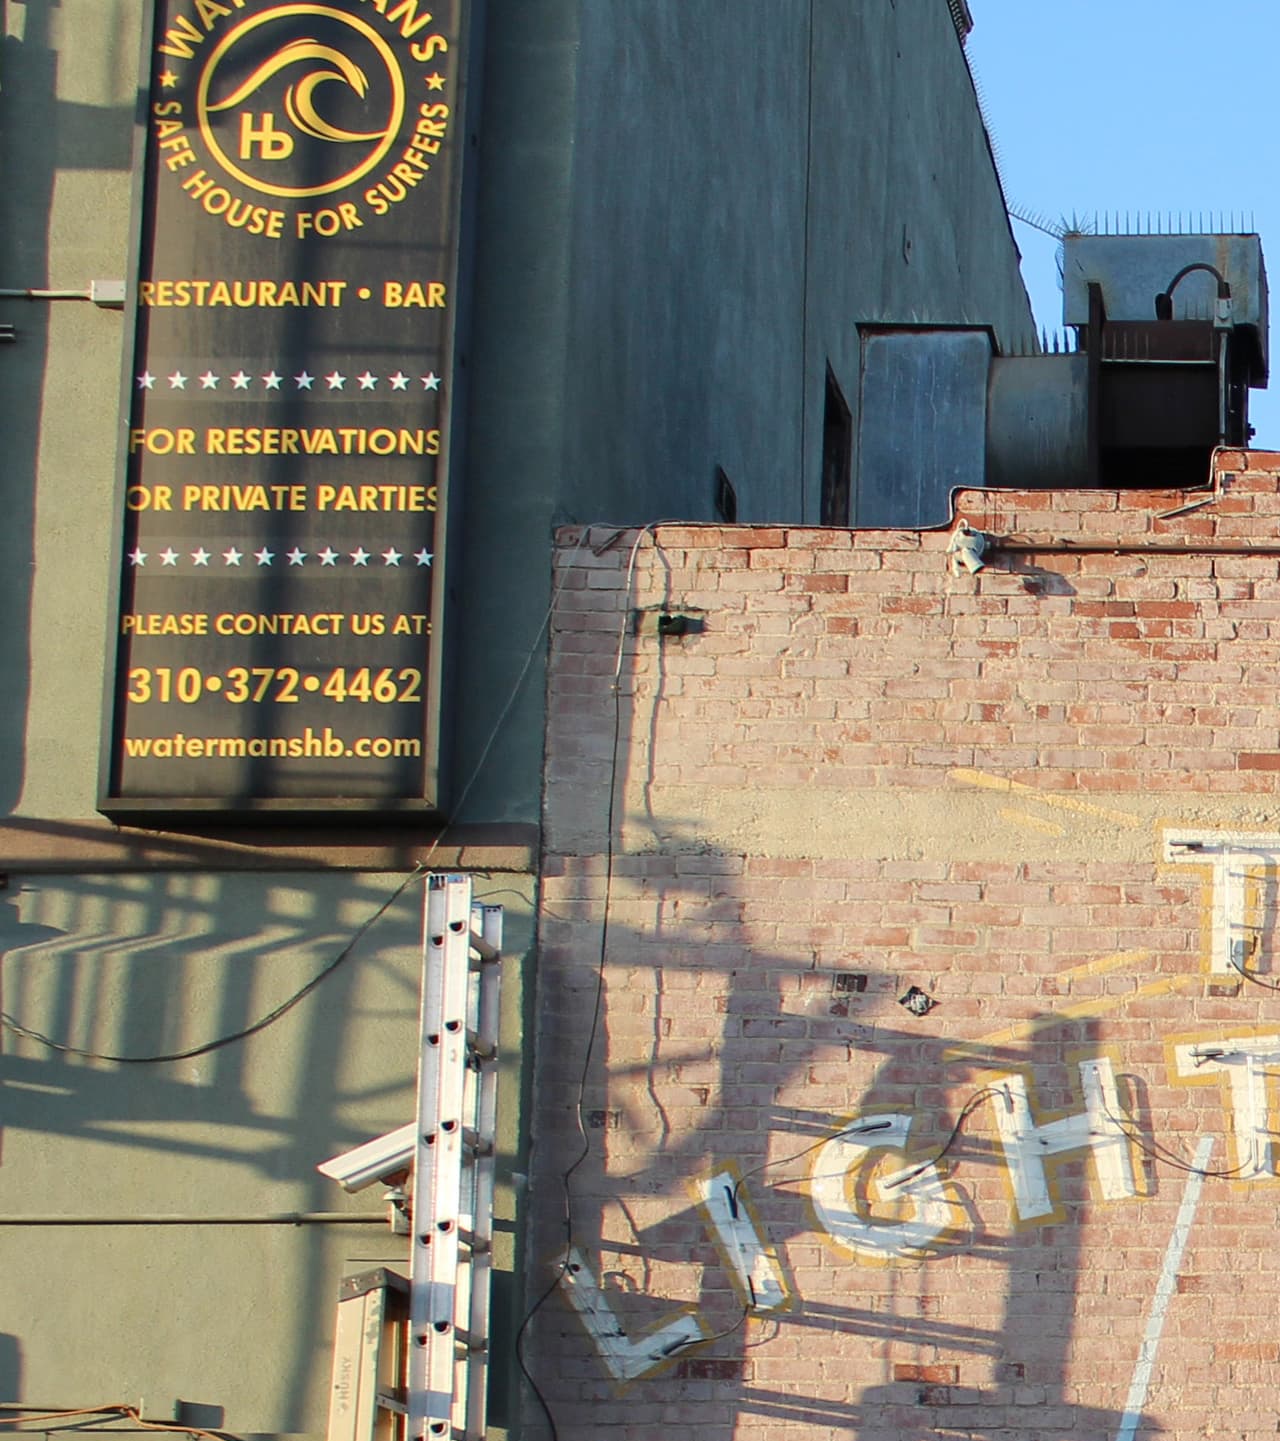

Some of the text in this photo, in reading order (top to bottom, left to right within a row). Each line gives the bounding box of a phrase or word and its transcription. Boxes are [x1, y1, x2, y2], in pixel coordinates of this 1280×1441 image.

[154, 101, 450, 240] SAFE HOUSE FOR SURFERS
[139, 281, 447, 308] RESTAURANT BAR
[131, 428, 440, 456] FOR RESERVATIONS
[183, 485, 307, 511] PRIVATE
[318, 485, 438, 512] PARTIES
[122, 614, 208, 636] PLEASE
[215, 613, 345, 636] CONTACT
[351, 614, 385, 636] US
[124, 727, 422, 759] watermanshb.com
